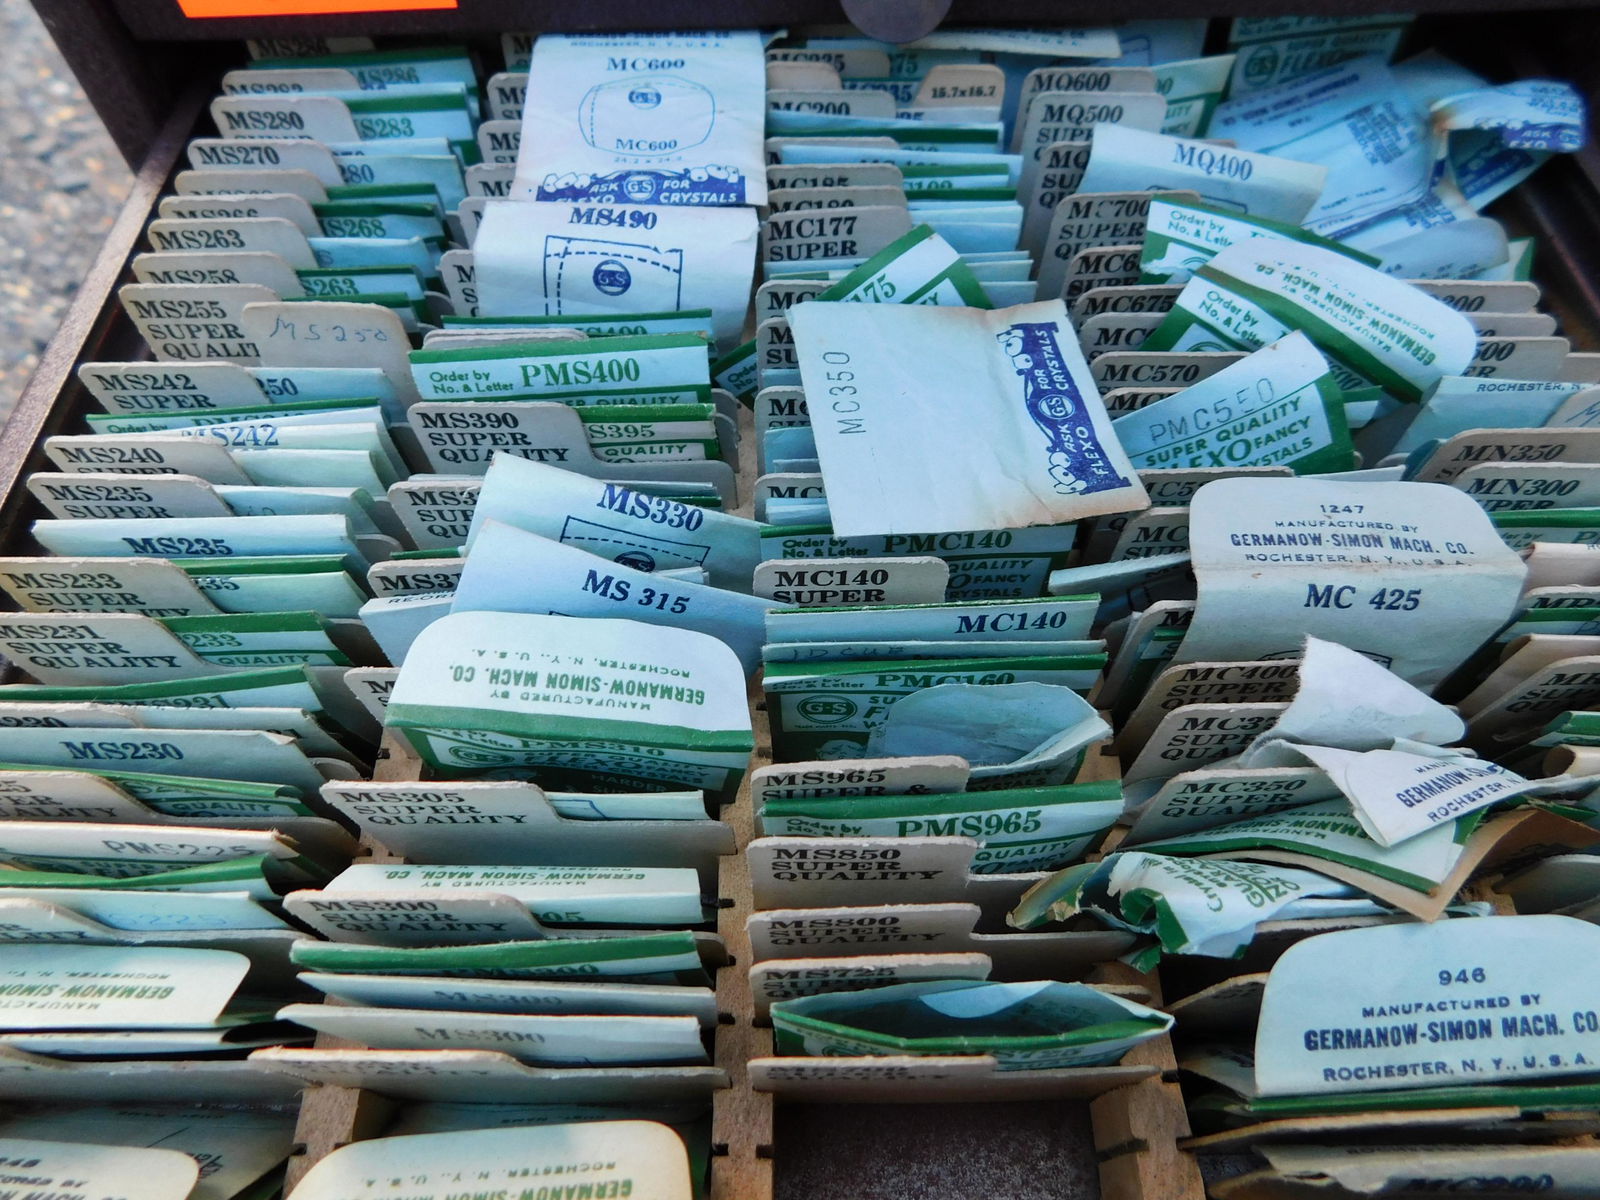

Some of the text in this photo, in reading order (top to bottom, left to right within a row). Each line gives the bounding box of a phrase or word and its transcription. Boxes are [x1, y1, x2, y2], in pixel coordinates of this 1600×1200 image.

[607, 57, 685, 71] MC600
[1032, 73, 1110, 92] MQ600
[223, 111, 304, 130] MS280
[1041, 104, 1124, 124] MQ500
[616, 138, 677, 150] MC600
[197, 146, 280, 165] MS270
[1173, 143, 1253, 180] MQ400
[589, 180, 690, 193] ASK FOR
[660, 192, 737, 203] CRYSTALS
[569, 207, 658, 230] MS490
[1171, 210, 1224, 232] Order by
[768, 216, 858, 241] MC177
[1059, 223, 1144, 240] SUPER
[1168, 221, 1189, 235] No.
[153, 230, 245, 250] MS263
[770, 240, 858, 262] SUPER
[147, 269, 239, 284] MS258
[135, 301, 227, 319] MS255
[1083, 295, 1178, 315] MC675
[1207, 291, 1259, 327] Order by
[1255, 262, 1436, 366] GERMANOW-SIMON MACH. CO.
[1199, 300, 1265, 346] No. Letter
[148, 324, 245, 339] SUPER
[430, 370, 491, 382] Order by
[520, 358, 640, 387] PMS400
[1103, 364, 1200, 382] MC570
[92, 374, 198, 390] MS242
[433, 383, 458, 394] No.
[474, 381, 514, 392] Letter
[1477, 383, 1565, 392] ROCHESTER,
[114, 394, 216, 408] SUPER
[823, 352, 866, 434] MC350
[1035, 369, 1077, 452] ASK FOR
[1036, 330, 1109, 475] FLEXO CRYSTALS
[417, 412, 519, 429] MS390
[432, 432, 532, 445] SUPER
[1145, 395, 1301, 467] SUPER QUALITY
[1254, 416, 1311, 448] FANCY
[64, 448, 164, 464] MS240
[439, 448, 570, 463] QUALITY
[605, 445, 687, 456] QUALITY
[1452, 444, 1567, 461] MN350
[43, 485, 153, 502] MS235
[1466, 478, 1580, 496] MN300
[64, 505, 174, 518] SUPER
[596, 484, 704, 532] MS330
[1320, 504, 1364, 514] 1247
[1275, 520, 1418, 534] MANUFACTURED BY
[123, 537, 233, 555] MS235
[783, 538, 847, 548] Order by
[882, 531, 1013, 552] PMC140
[1231, 533, 1475, 556] GERMANOW-SIMON MACH. CO.
[1246, 553, 1354, 565] ROCHESTER,
[2, 573, 123, 589] MS233
[775, 569, 889, 587] MC140
[974, 575, 1031, 584] FANCY
[28, 592, 147, 605] SUPER
[582, 569, 690, 614] MS 315
[773, 590, 885, 603] SUPER
[1304, 583, 1422, 611] MC 425
[955, 611, 1067, 634] MC140
[0, 625, 106, 639] MS231
[7, 642, 132, 654] SUPER
[31, 655, 182, 668] QUALITY
[218, 654, 310, 665] QUALITY
[594, 658, 690, 678] ROCHESTER,
[1176, 666, 1295, 682] MC400
[449, 664, 705, 705] GERMANOW-SIMON MACH. CO.
[1166, 682, 1287, 696] SUPER
[490, 690, 650, 710] MANUFACTURED BY
[60, 742, 184, 760] MS230
[763, 770, 887, 787] MS965
[762, 784, 932, 800] SUPER &
[1179, 780, 1307, 794] MC350
[338, 792, 466, 803] MS305
[1168, 793, 1296, 807] SUPER
[1427, 782, 1508, 822] ROCHESTER,
[173, 803, 271, 811] QUALITY
[353, 806, 483, 814] SUPER
[368, 815, 528, 825] QUALITY
[896, 810, 1042, 837] PMS965
[773, 849, 901, 860] MS850
[975, 840, 1071, 861] QUALITY
[771, 862, 902, 870] SUPER
[385, 871, 645, 880] GERMANOW-SIMON MACH. CO.
[773, 871, 943, 880] QUALITY
[310, 901, 439, 912] MS300
[322, 914, 459, 922] SUPER
[768, 916, 900, 929] MS800
[335, 922, 509, 932] QUALITY
[770, 928, 901, 937] SUPER
[770, 933, 944, 945] QUALITY
[765, 968, 896, 979] MS725
[1438, 967, 1486, 986] 946
[1362, 995, 1541, 1019] MANUFACTURED BY
[415, 1026, 546, 1044] MS300
[1304, 1012, 1600, 1051] GERMANOW-SIMON MACH. CO
[1323, 1053, 1594, 1082] ROCHESTER, N. Y., U. S. A.
[504, 1162, 616, 1177] ROCHESTER,
